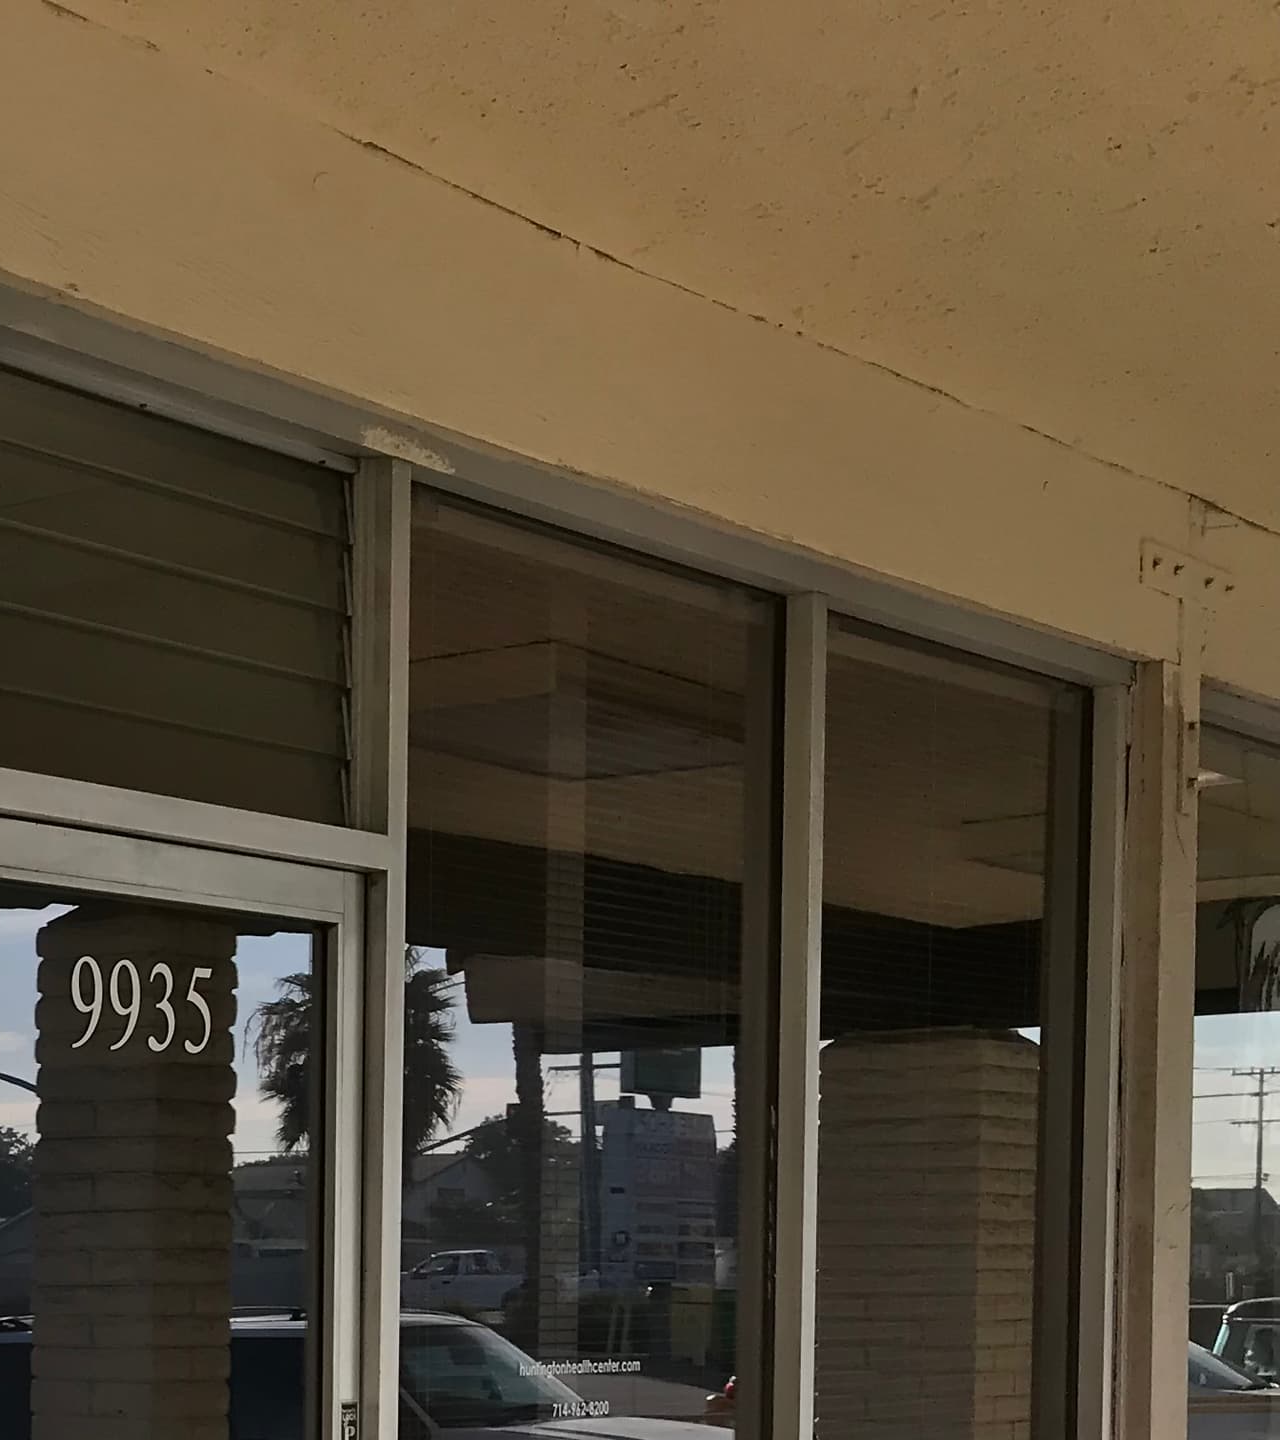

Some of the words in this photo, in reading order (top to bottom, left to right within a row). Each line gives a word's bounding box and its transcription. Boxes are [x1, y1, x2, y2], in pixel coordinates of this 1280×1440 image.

[71, 955, 213, 1054] 9935
[519, 1359, 641, 1378] huntingtonhealthcenter.com
[552, 1401, 609, 1417] 714-962-8200
